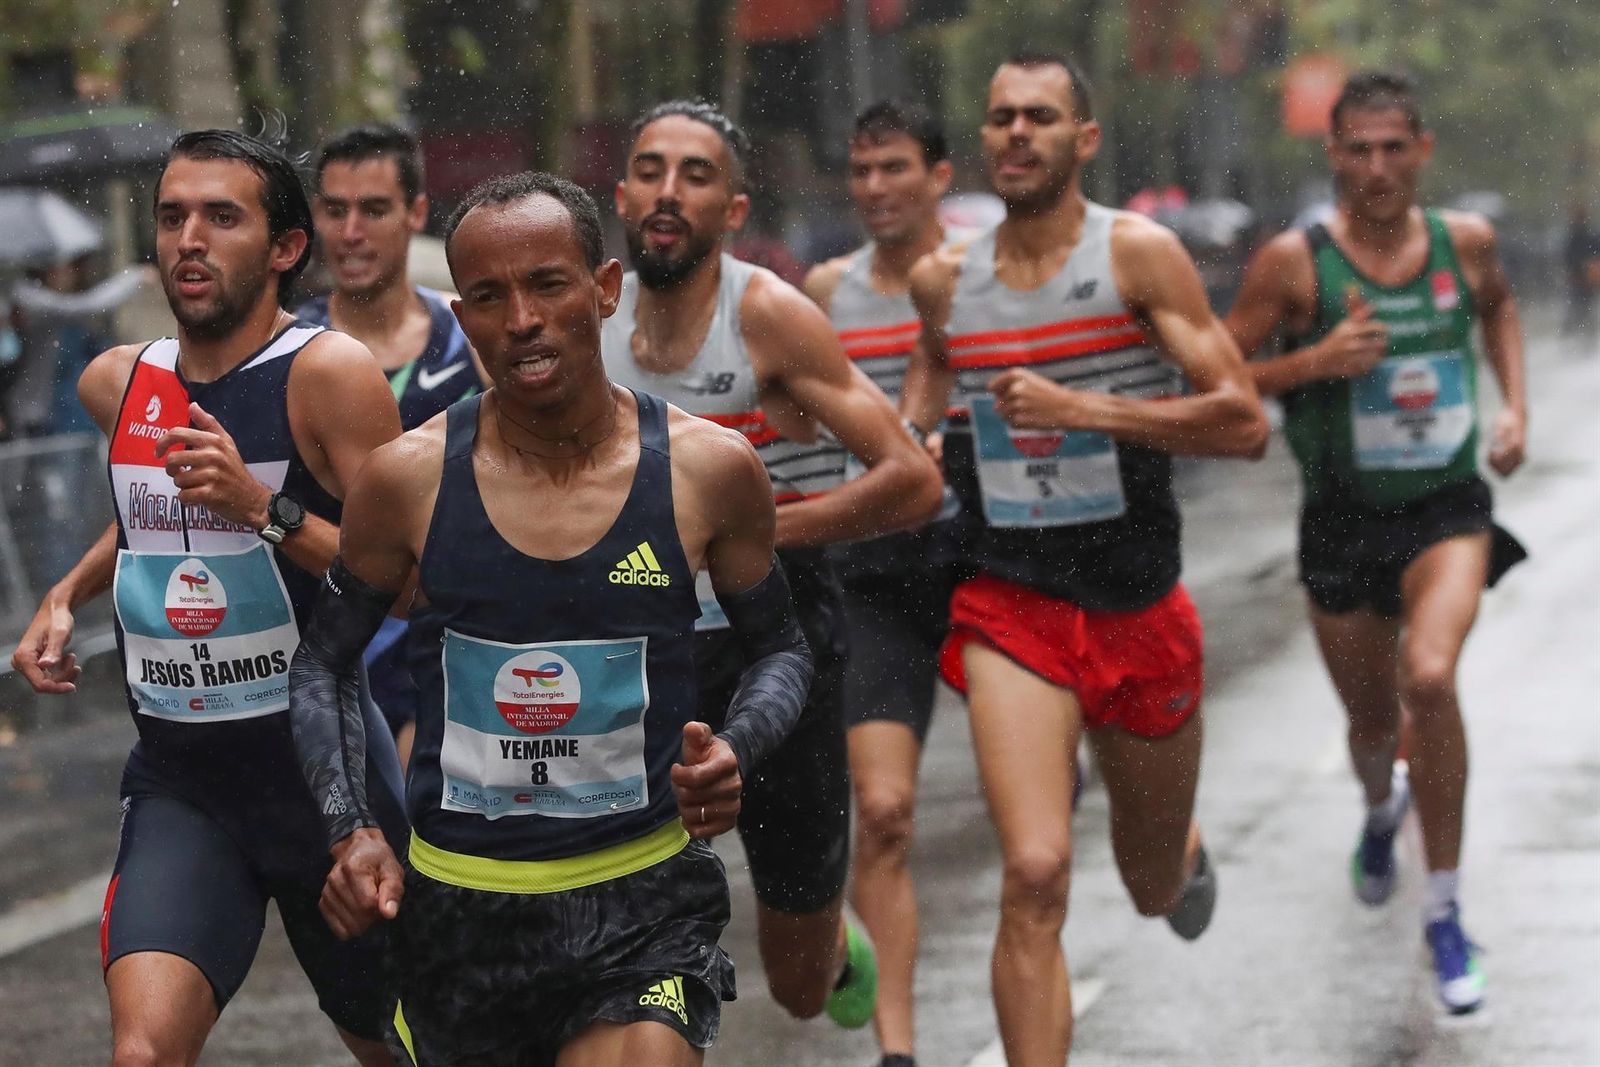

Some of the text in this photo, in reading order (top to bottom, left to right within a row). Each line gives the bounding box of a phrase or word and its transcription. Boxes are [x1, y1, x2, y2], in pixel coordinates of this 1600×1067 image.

[608, 568, 671, 587] adidas
[178, 596, 214, 604] TotalEnergies
[190, 643, 211, 662] 14
[140, 650, 288, 688] JESÚS RAMOS
[512, 691, 565, 700] TotalEnergies
[499, 739, 579, 760] YEMANE
[531, 761, 549, 786] 8
[638, 991, 689, 1025] adidas
